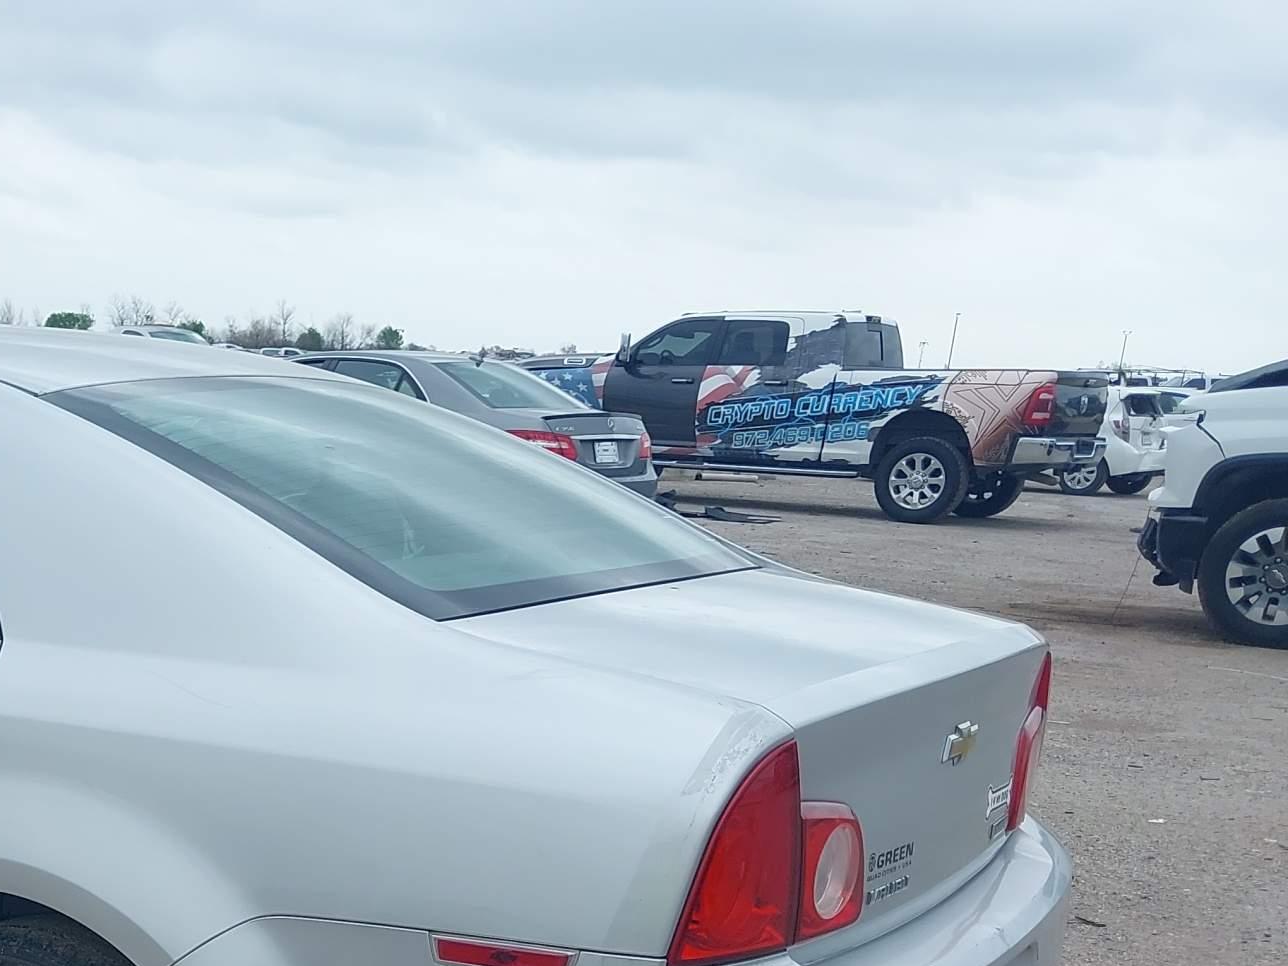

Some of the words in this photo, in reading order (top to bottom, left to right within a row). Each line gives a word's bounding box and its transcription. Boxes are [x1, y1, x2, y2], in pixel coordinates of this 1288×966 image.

[707, 398, 791, 426] CRYPTO
[795, 384, 923, 416] CURRENCY
[876, 841, 914, 869] GREEN
